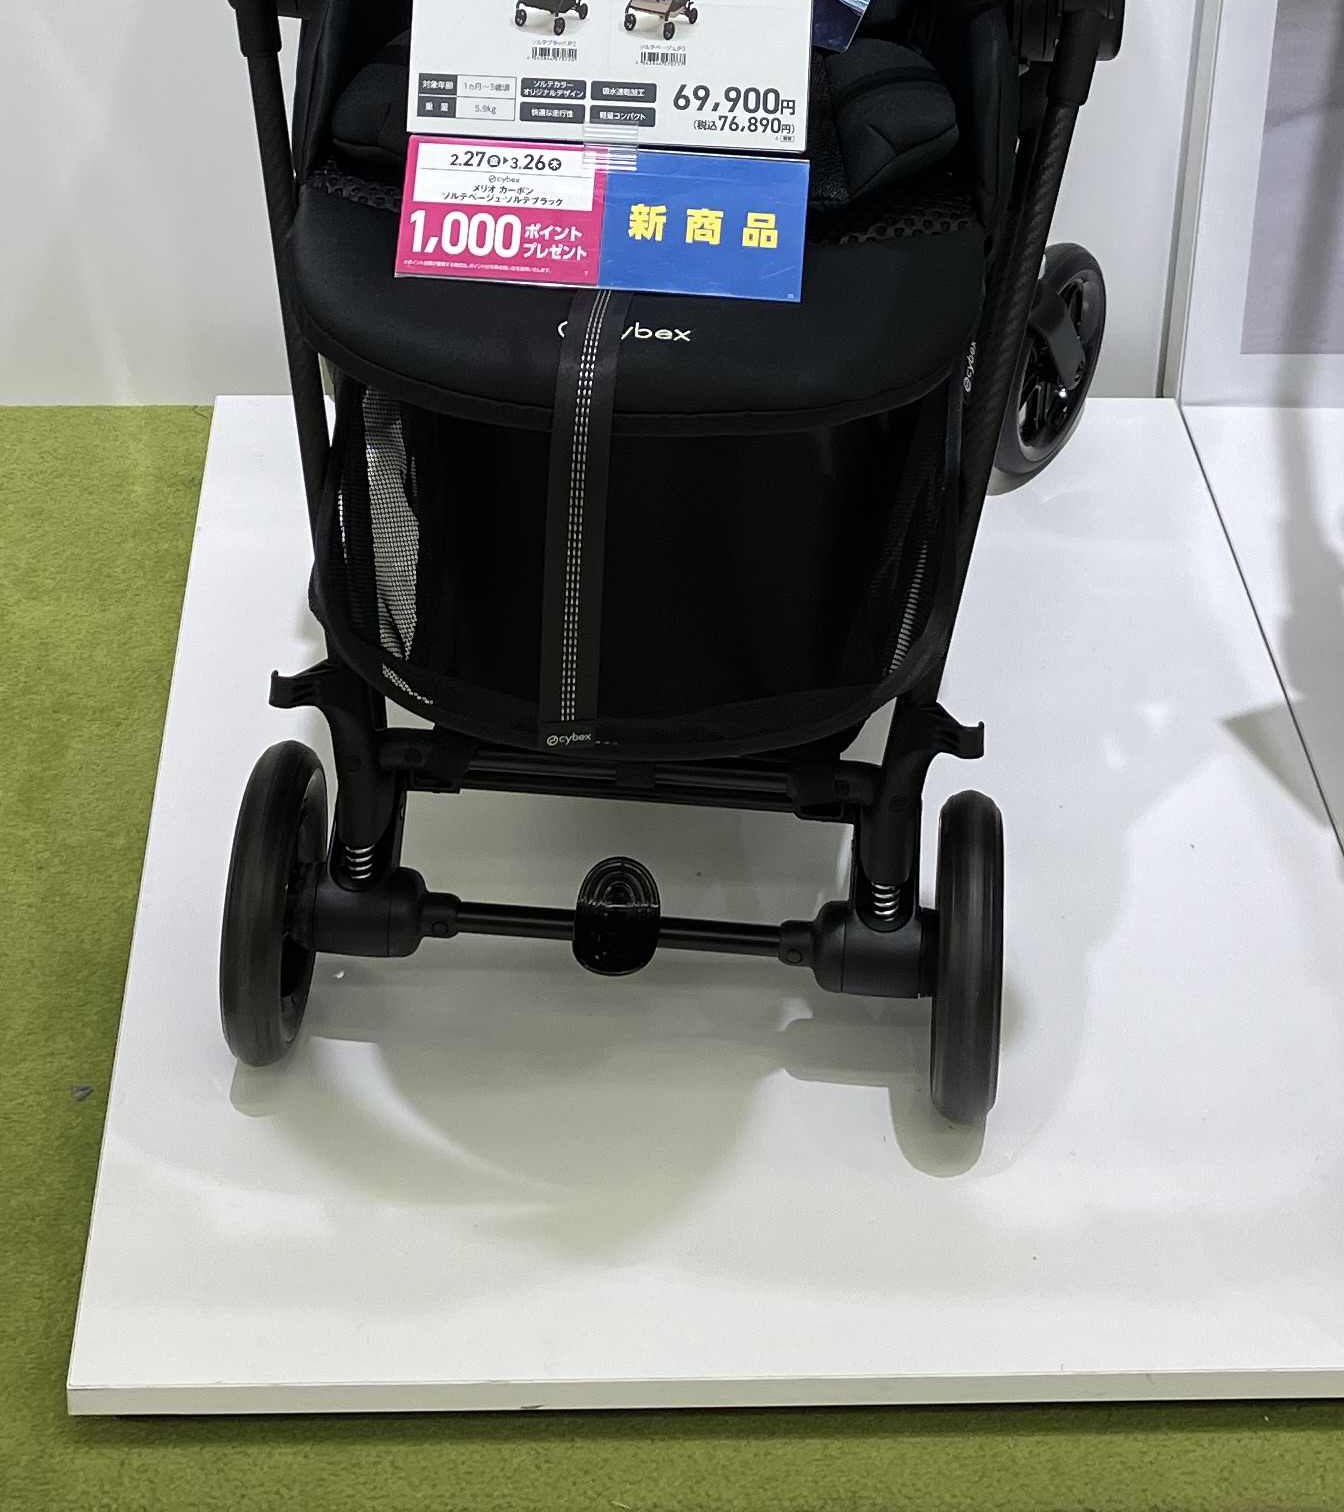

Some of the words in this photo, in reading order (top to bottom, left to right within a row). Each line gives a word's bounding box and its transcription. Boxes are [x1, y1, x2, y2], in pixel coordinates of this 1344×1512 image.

[672, 84, 796, 116] 69,900円
[409, 209, 522, 258] 1,000
[523, 223, 583, 241] ポイント
[628, 203, 779, 249] 新商品
[522, 243, 588, 261] プレゼント
[558, 731, 593, 746] cybex
